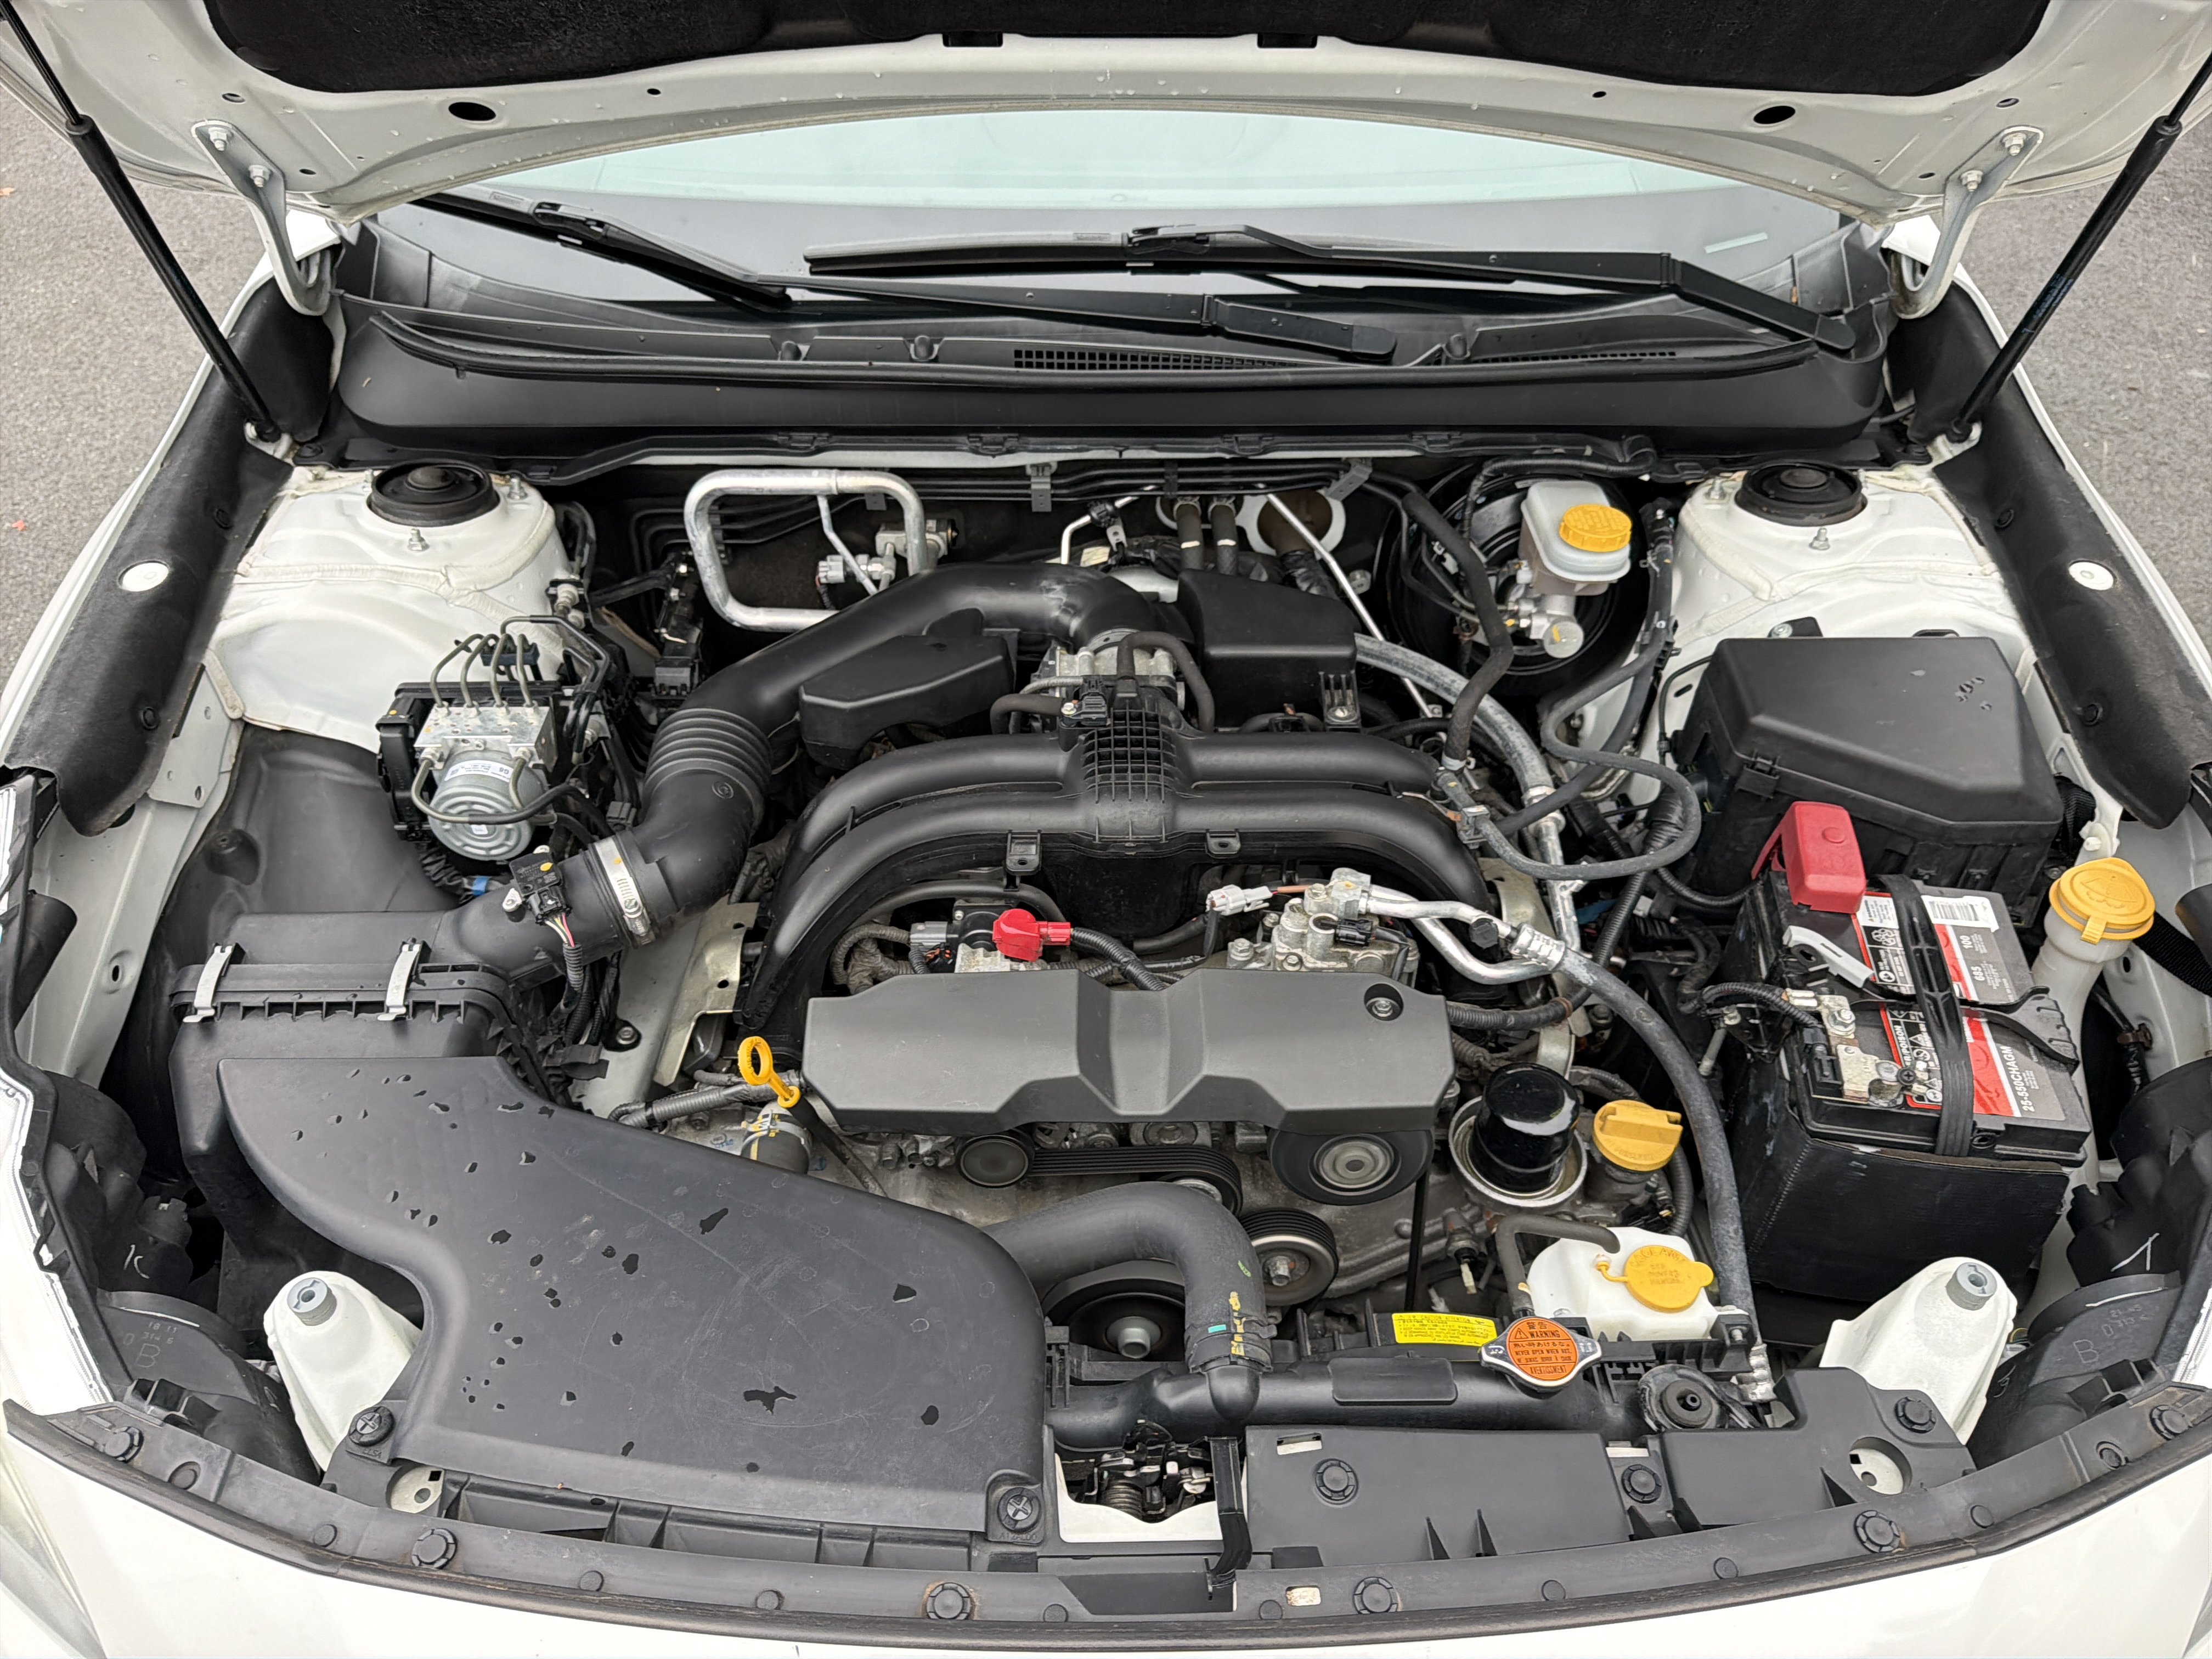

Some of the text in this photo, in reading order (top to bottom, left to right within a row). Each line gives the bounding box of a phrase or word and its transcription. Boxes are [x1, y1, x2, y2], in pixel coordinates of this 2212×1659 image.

[1960, 935, 1973, 949] 100
[1971, 966, 1985, 981] 685
[2000, 1046, 2035, 1112] 25-550CHAGM
[1529, 1330, 1561, 1339] WARNING
[135, 1343, 161, 1368] B
[2073, 1339, 2099, 1363] B
